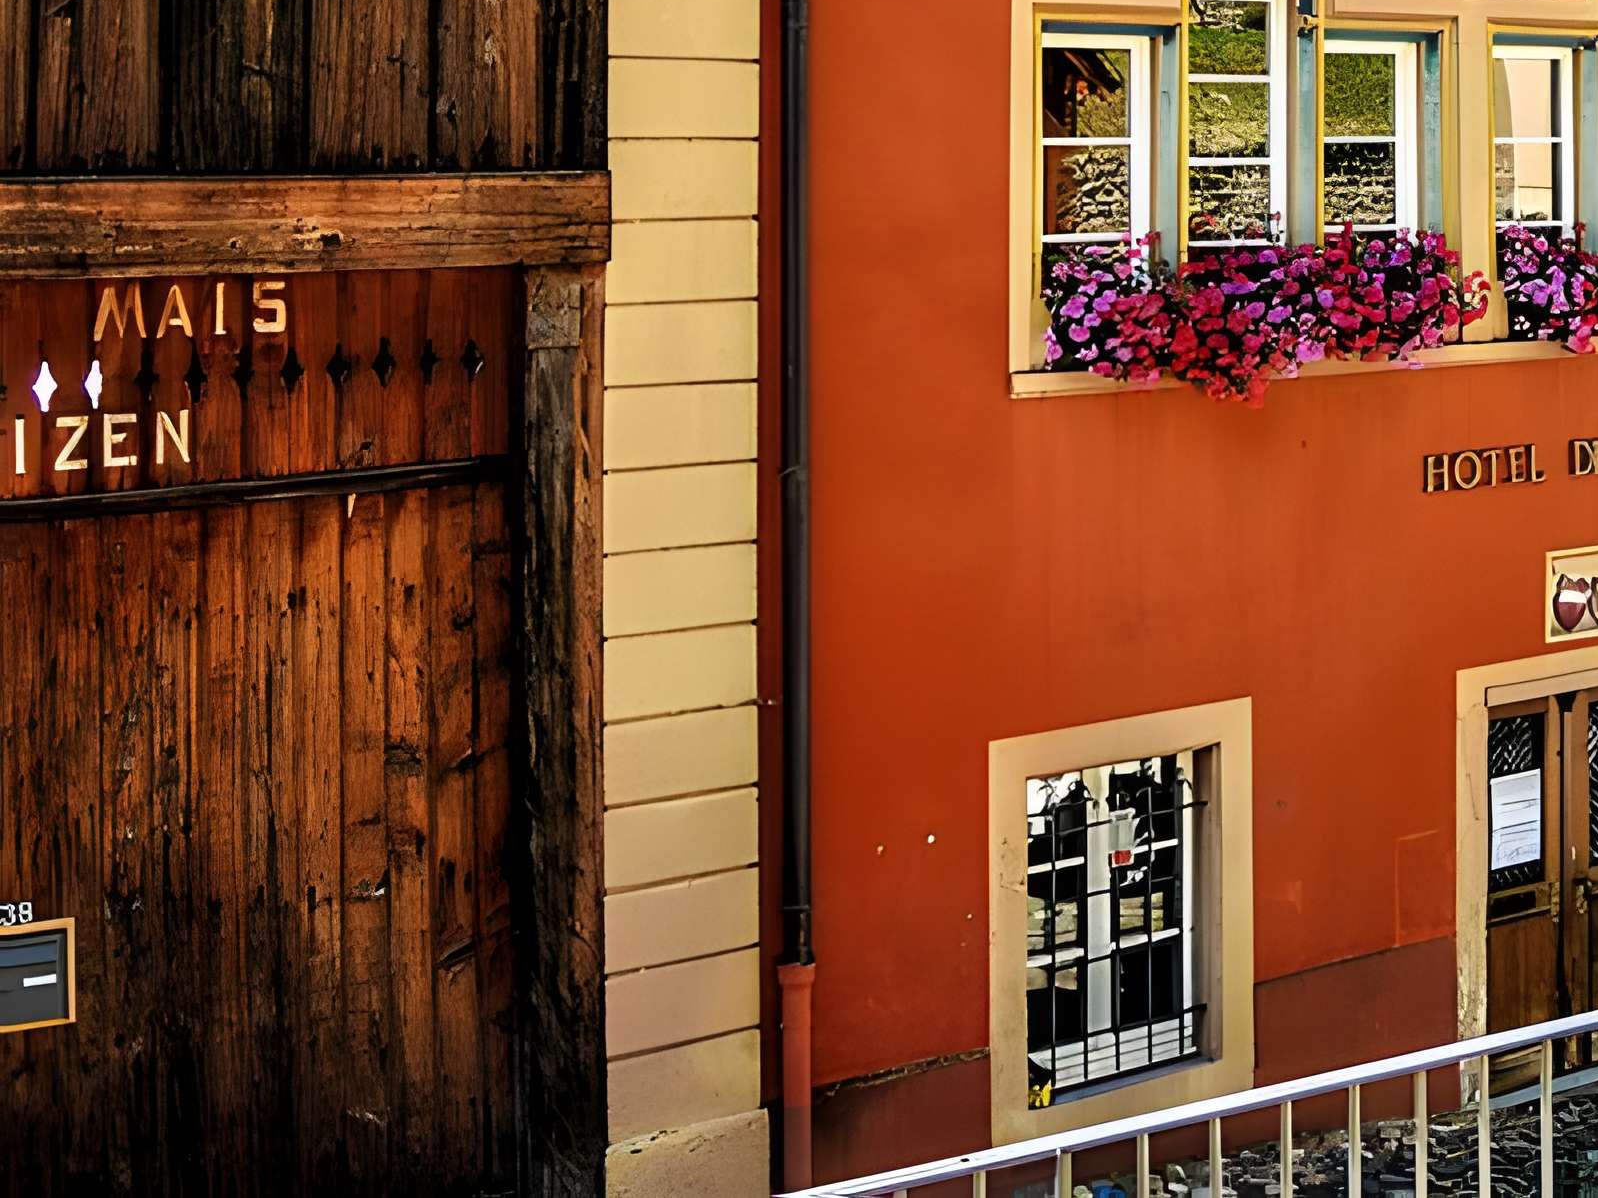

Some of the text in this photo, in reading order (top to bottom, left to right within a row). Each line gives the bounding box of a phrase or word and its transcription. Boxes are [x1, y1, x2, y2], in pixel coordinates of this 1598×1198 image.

[93, 282, 286, 341] MAIS
[15, 409, 190, 474] IZEN
[1424, 443, 1546, 492] HOTEL
